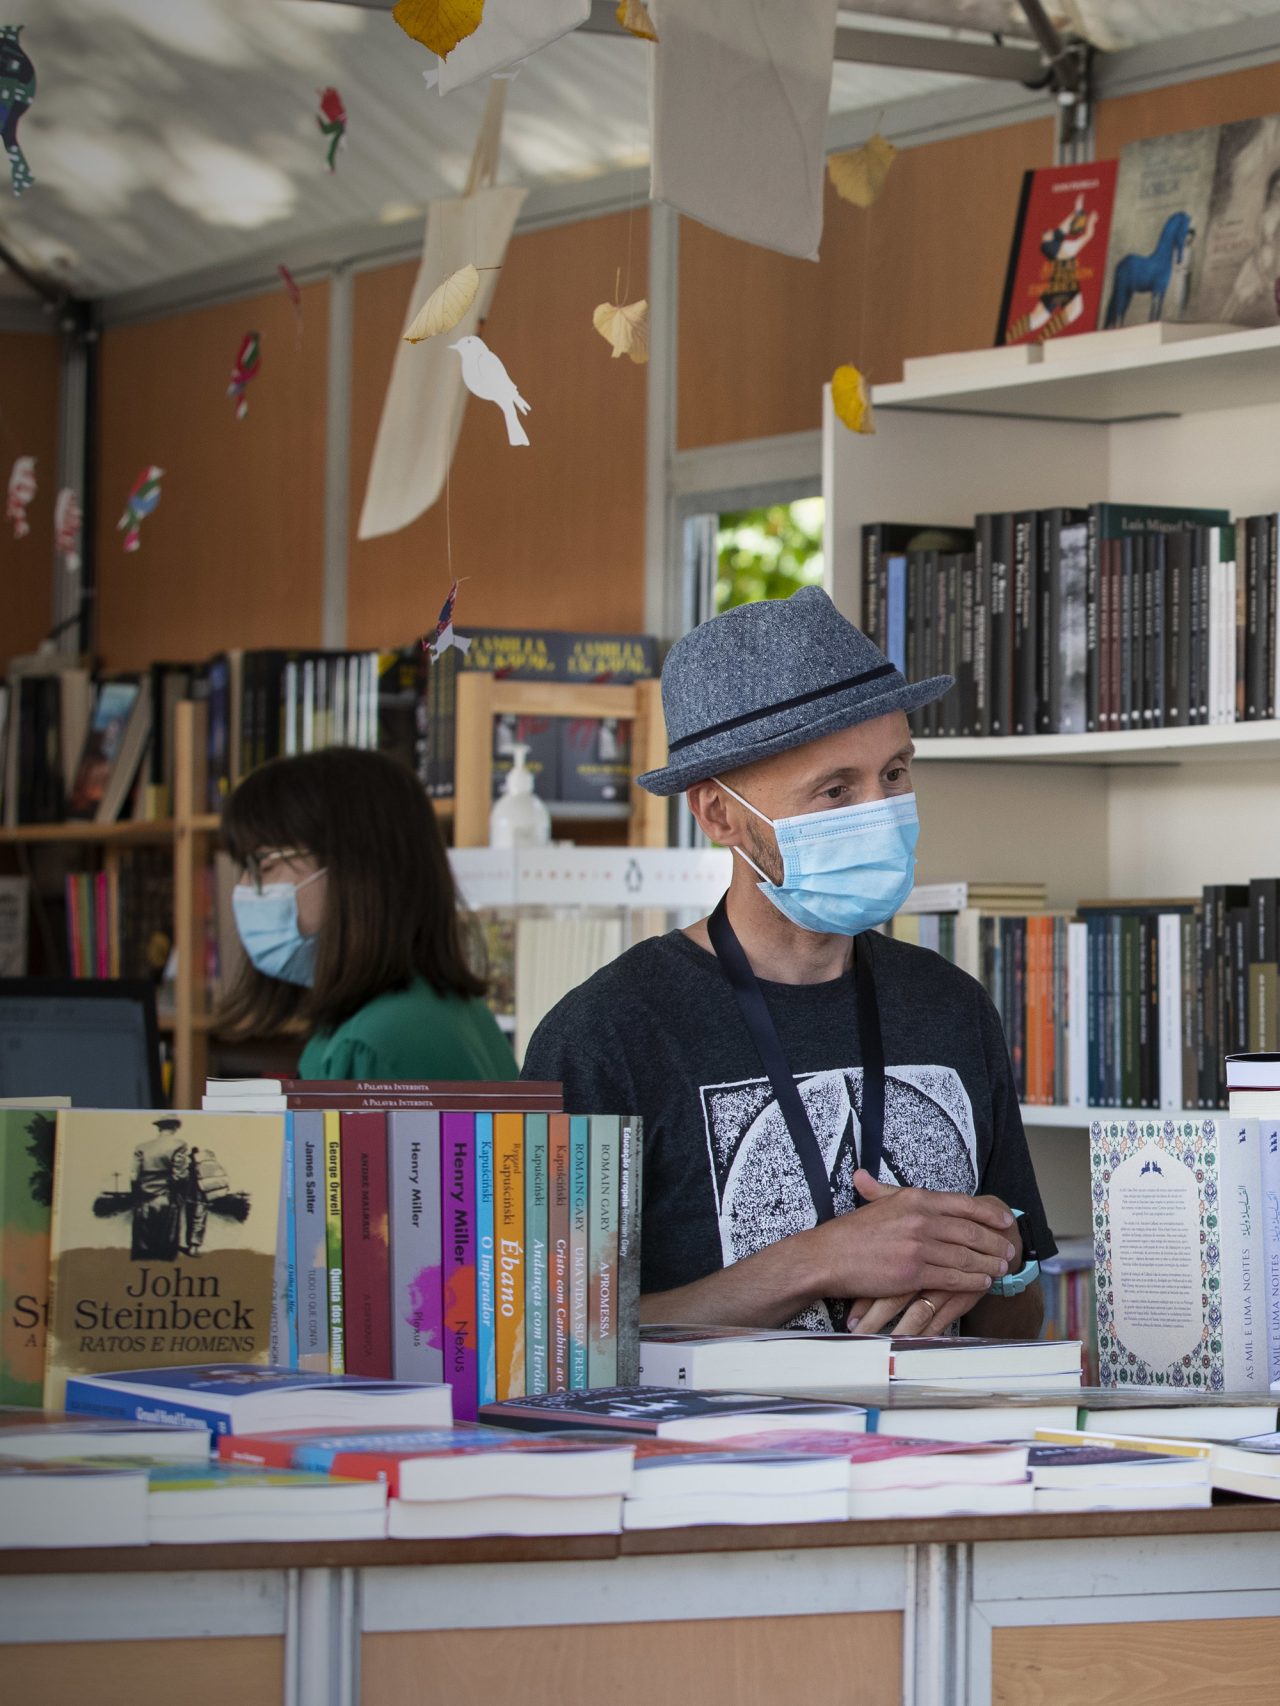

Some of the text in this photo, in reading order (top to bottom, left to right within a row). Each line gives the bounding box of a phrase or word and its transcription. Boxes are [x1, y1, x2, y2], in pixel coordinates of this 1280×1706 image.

[621, 1127, 632, 1168] Educação
[305, 1141, 316, 1216] James Salter
[329, 1142, 342, 1216] George Orwell
[409, 1142, 424, 1228] Henry Miller
[575, 1143, 584, 1232] ROMAIN GARY
[601, 1144, 610, 1232] ROMAIN GARY
[620, 1170, 632, 1208] europeia
[451, 1142, 470, 1266] Henry Miller
[501, 1238, 524, 1318] Ébano
[531, 1239, 544, 1308] Andanças
[556, 1239, 566, 1276] Cristo
[575, 1247, 584, 1276] UMA
[1271, 1253, 1280, 1298] NOITES
[126, 1267, 222, 1298] John
[481, 1236, 494, 1328] O Imperador
[556, 1278, 566, 1304] com
[575, 1278, 584, 1310] VIDA
[600, 1262, 610, 1338] A PROMESSA
[74, 1299, 256, 1332] Steinbeck
[308, 1319, 318, 1348] CONTA
[331, 1268, 346, 1370] Quinta dos Animais
[413, 1312, 424, 1348] Plexus
[534, 1310, 542, 1340] com
[575, 1323, 584, 1346] SUA
[1242, 1248, 1254, 1380] AS MIL E UMA NOITES
[1272, 1300, 1280, 1332] UMA
[79, 1336, 256, 1352] RATOS E HOMENS
[455, 1321, 468, 1374] Nexus
[556, 1308, 568, 1364] Carabina
[1273, 1334, 1280, 1342] E
[556, 1370, 564, 1382] ao
